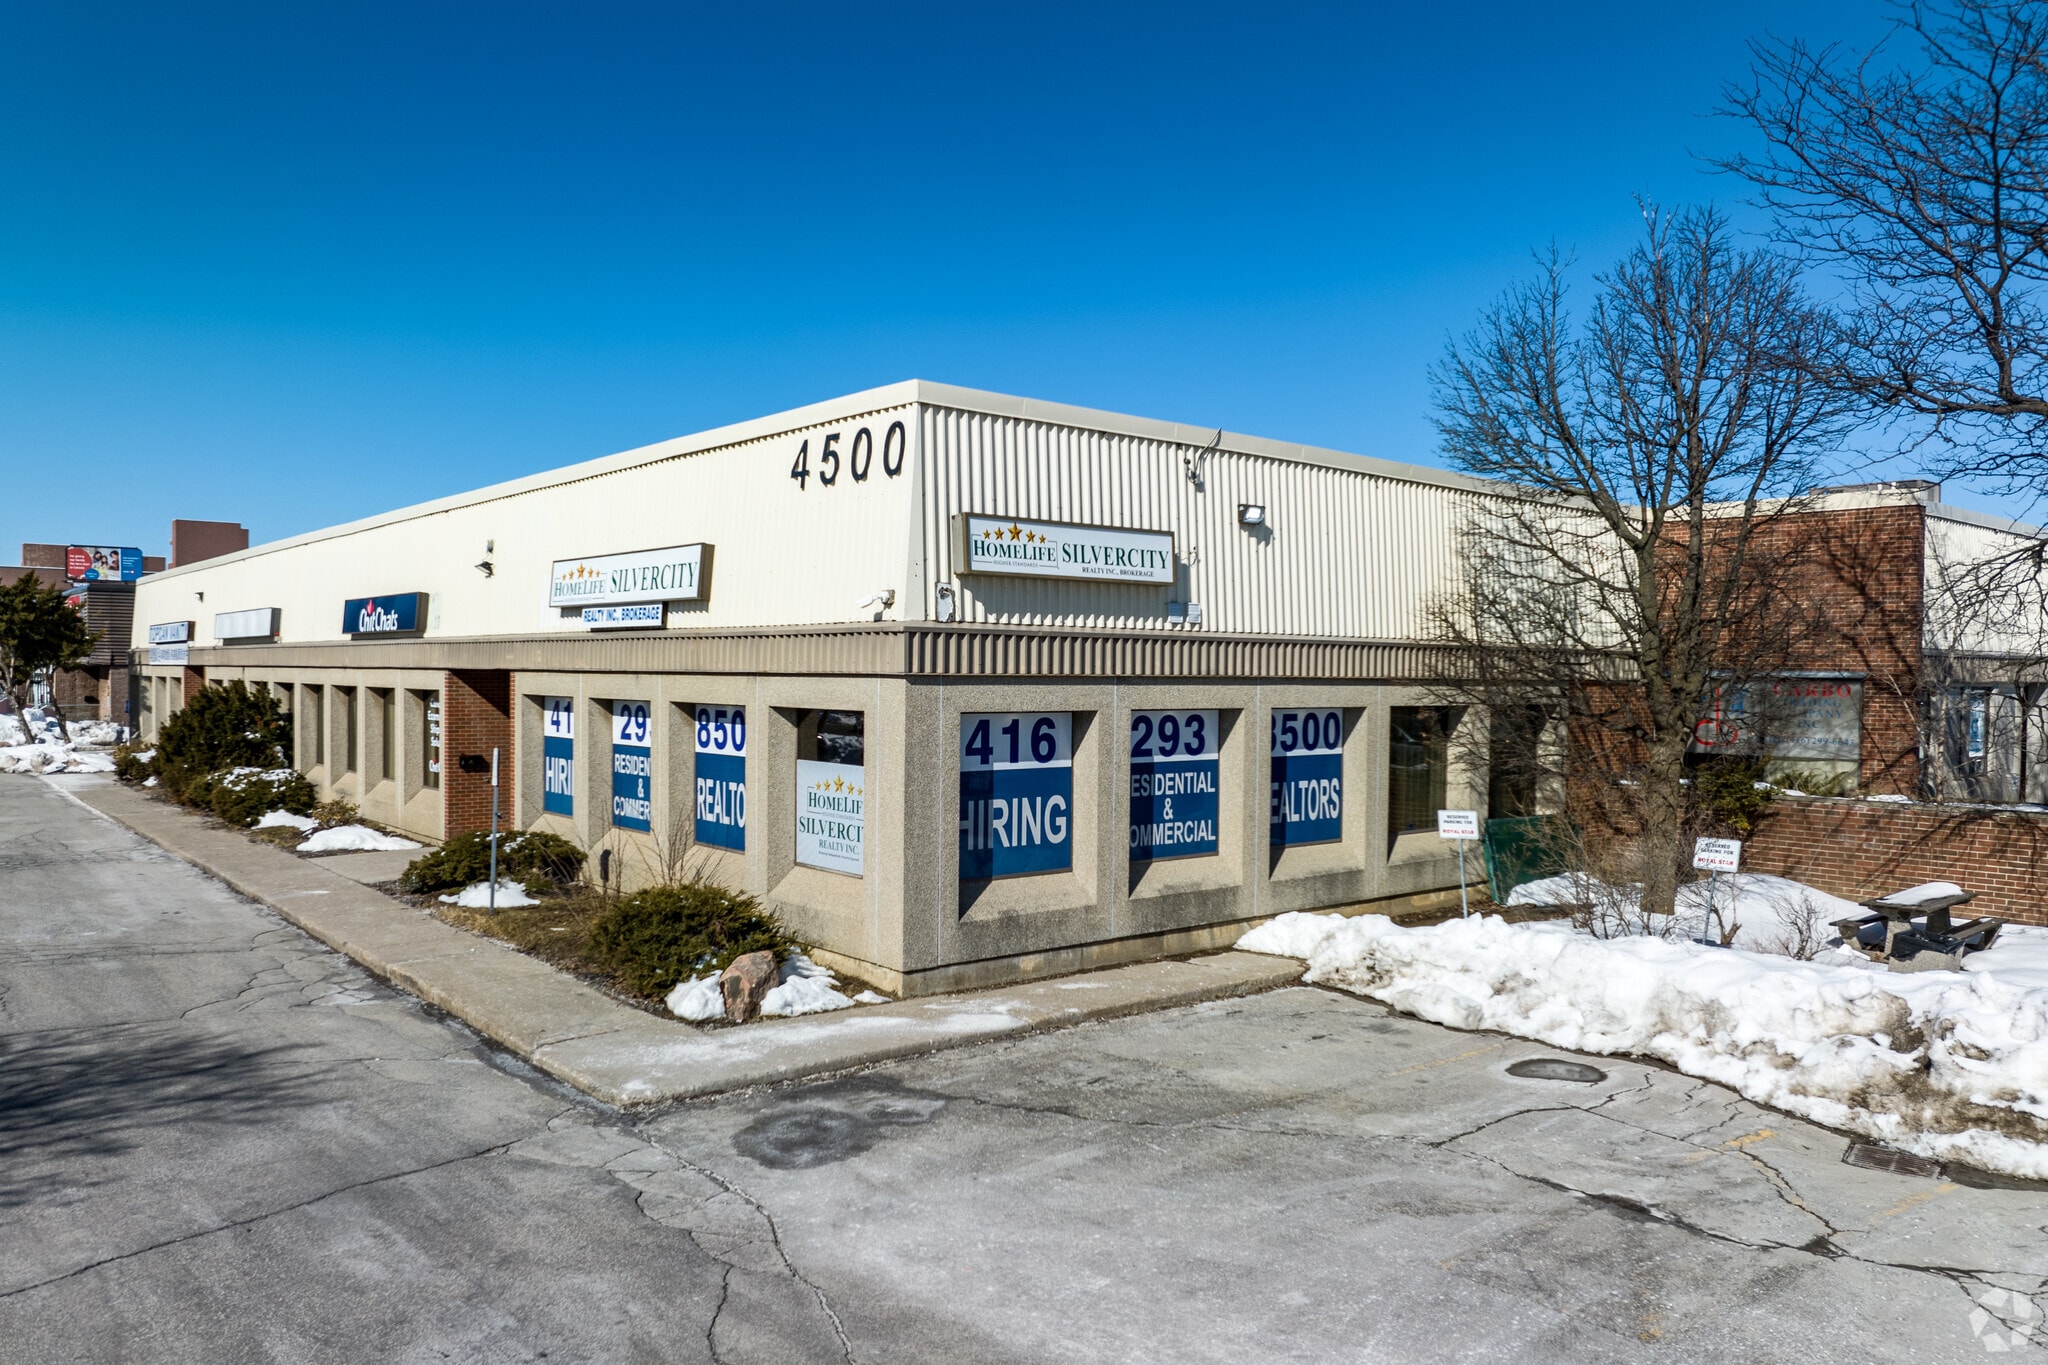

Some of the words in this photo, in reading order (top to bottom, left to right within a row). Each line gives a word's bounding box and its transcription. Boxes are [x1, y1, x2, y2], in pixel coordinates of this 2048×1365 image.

[791, 421, 905, 491] 4500
[1062, 542, 1169, 569] SILVERCITY
[610, 562, 699, 593] SILVERCITY
[1119, 569, 1154, 577] BROKERAGE
[583, 609, 605, 622] REALTY
[621, 606, 660, 621] BROKERAGE
[551, 700, 571, 734] 41
[620, 704, 651, 743] 29
[697, 708, 745, 752] 850
[965, 717, 1057, 765] 416
[1131, 714, 1206, 758] 293
[637, 778, 644, 798] &
[697, 777, 745, 828] REALTO
[1163, 797, 1174, 820] &
[799, 815, 864, 842] SILVERCI
[819, 838, 844, 852] REALTY
[845, 843, 860, 855] INC.
